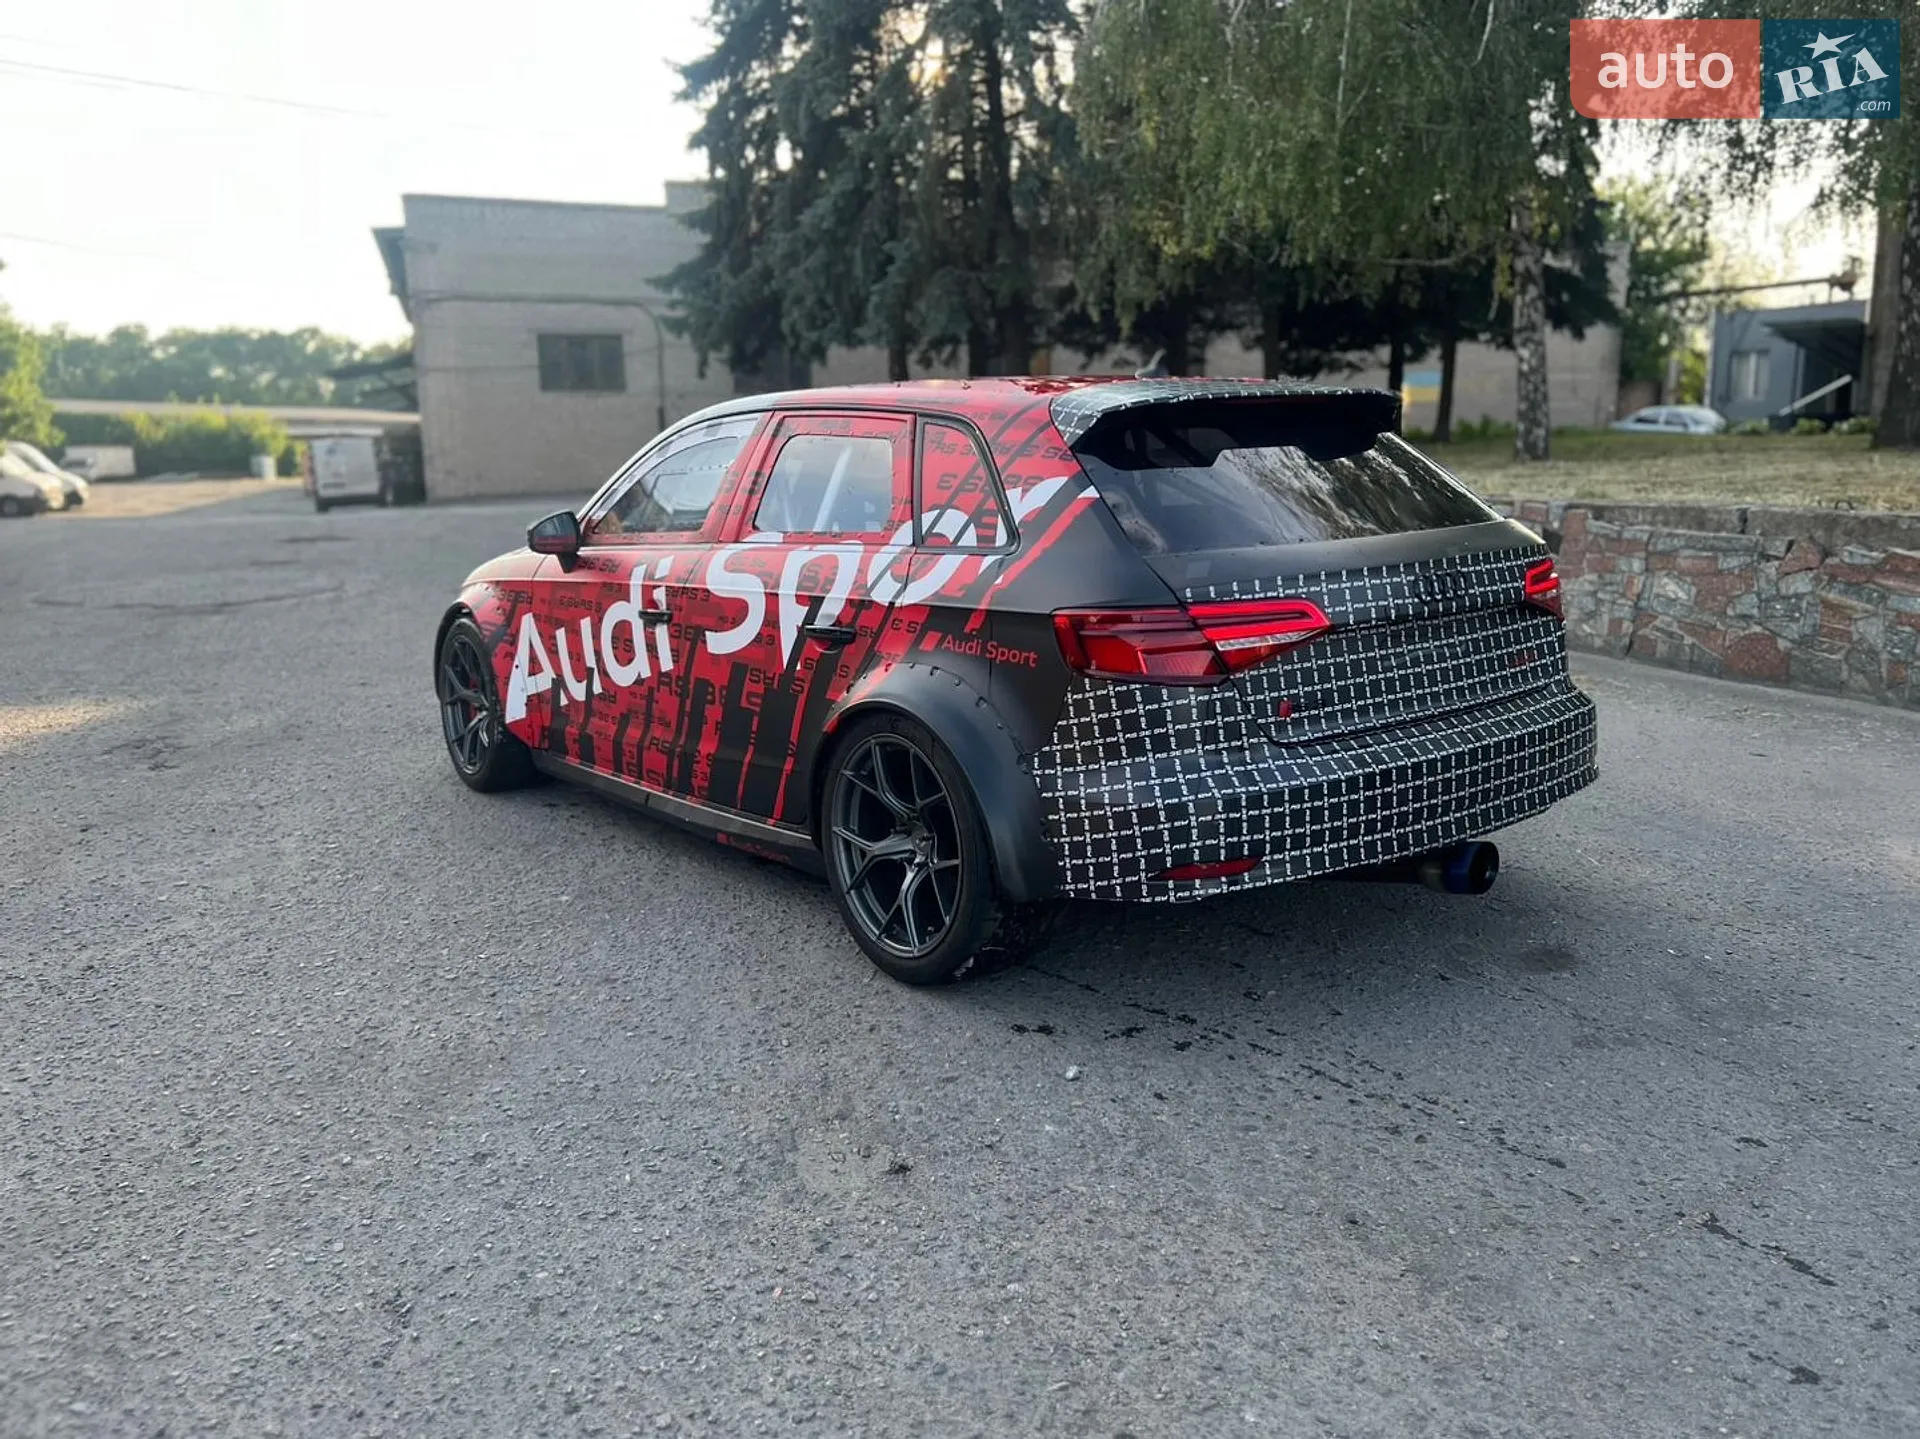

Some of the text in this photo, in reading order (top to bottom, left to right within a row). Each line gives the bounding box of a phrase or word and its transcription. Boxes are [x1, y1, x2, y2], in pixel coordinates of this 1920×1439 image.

[505, 555, 675, 725] Audi
[941, 633, 1039, 668] Audi Sport
